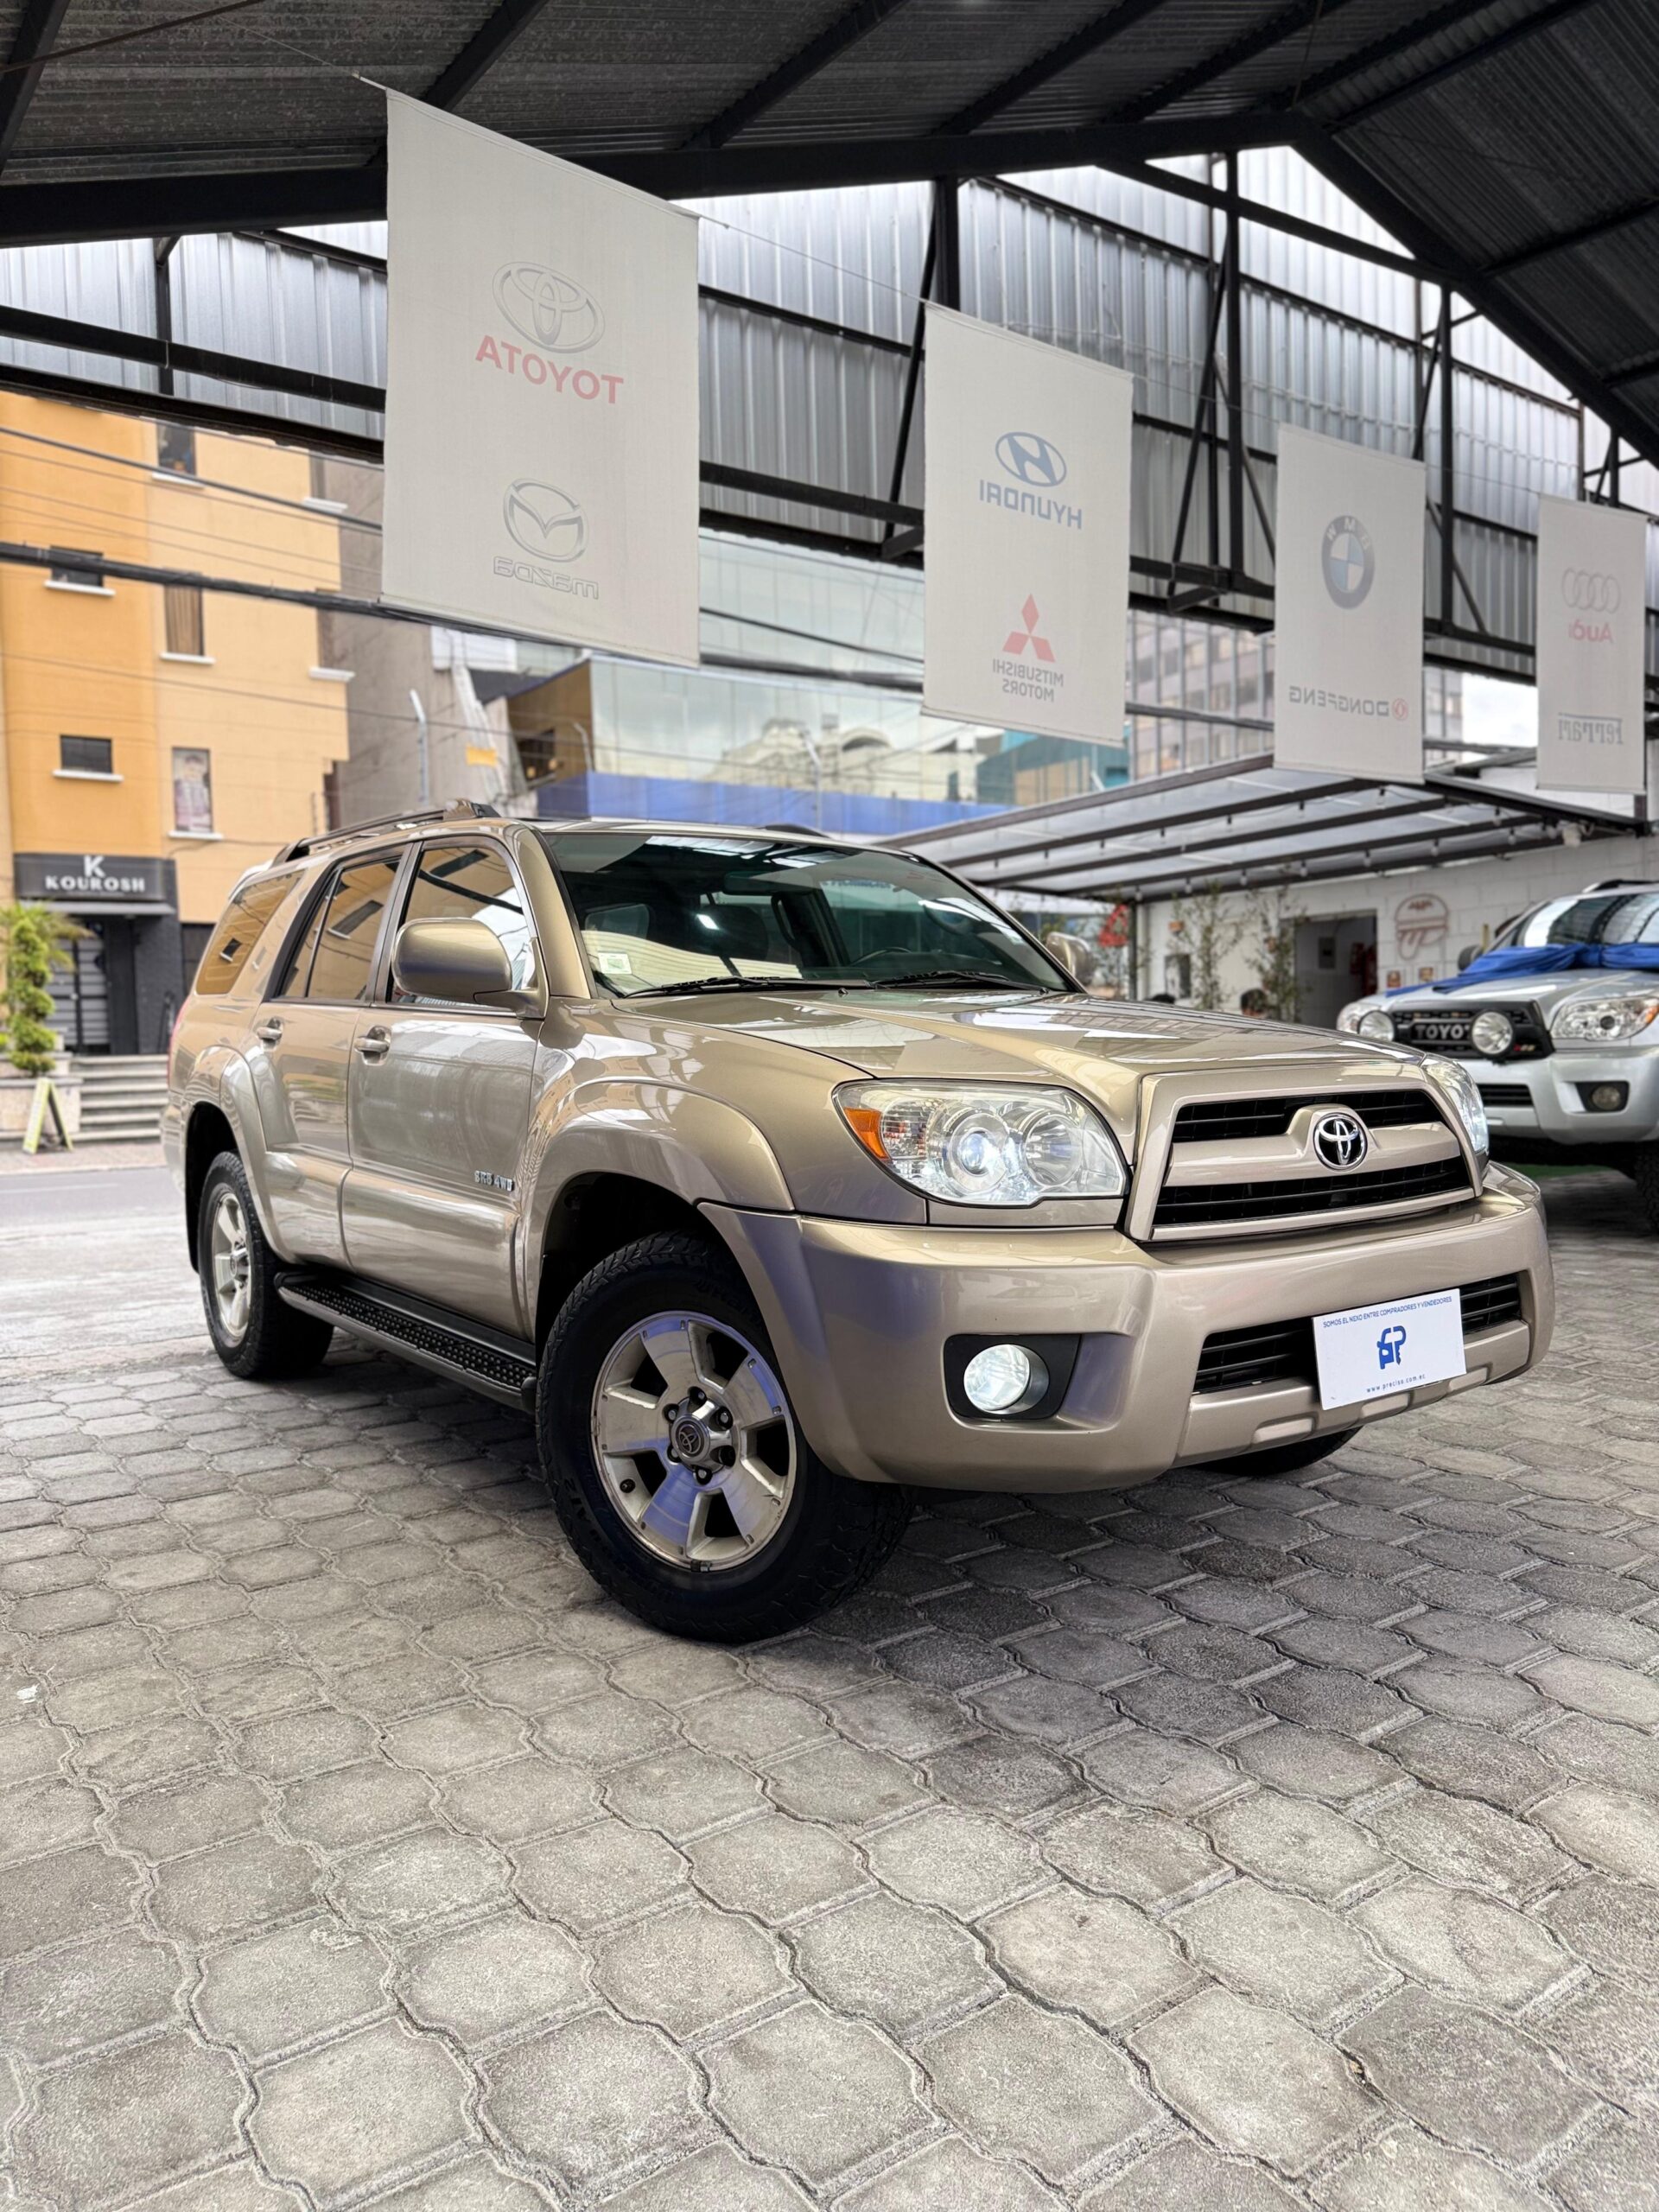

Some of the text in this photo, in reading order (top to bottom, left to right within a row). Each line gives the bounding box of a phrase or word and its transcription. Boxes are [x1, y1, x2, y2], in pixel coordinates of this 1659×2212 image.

[84, 855, 105, 877] K
[45, 875, 145, 893] KOUROSH
[1415, 1024, 1469, 1041] TOYO
[1323, 1319, 1342, 1328] SOMOS
[1349, 1314, 1363, 1323] NEXO
[1363, 1311, 1380, 1319] ENTRE
[1380, 1303, 1417, 1316] COMPRADORES
[1421, 1296, 1452, 1308] VENDEDORES
